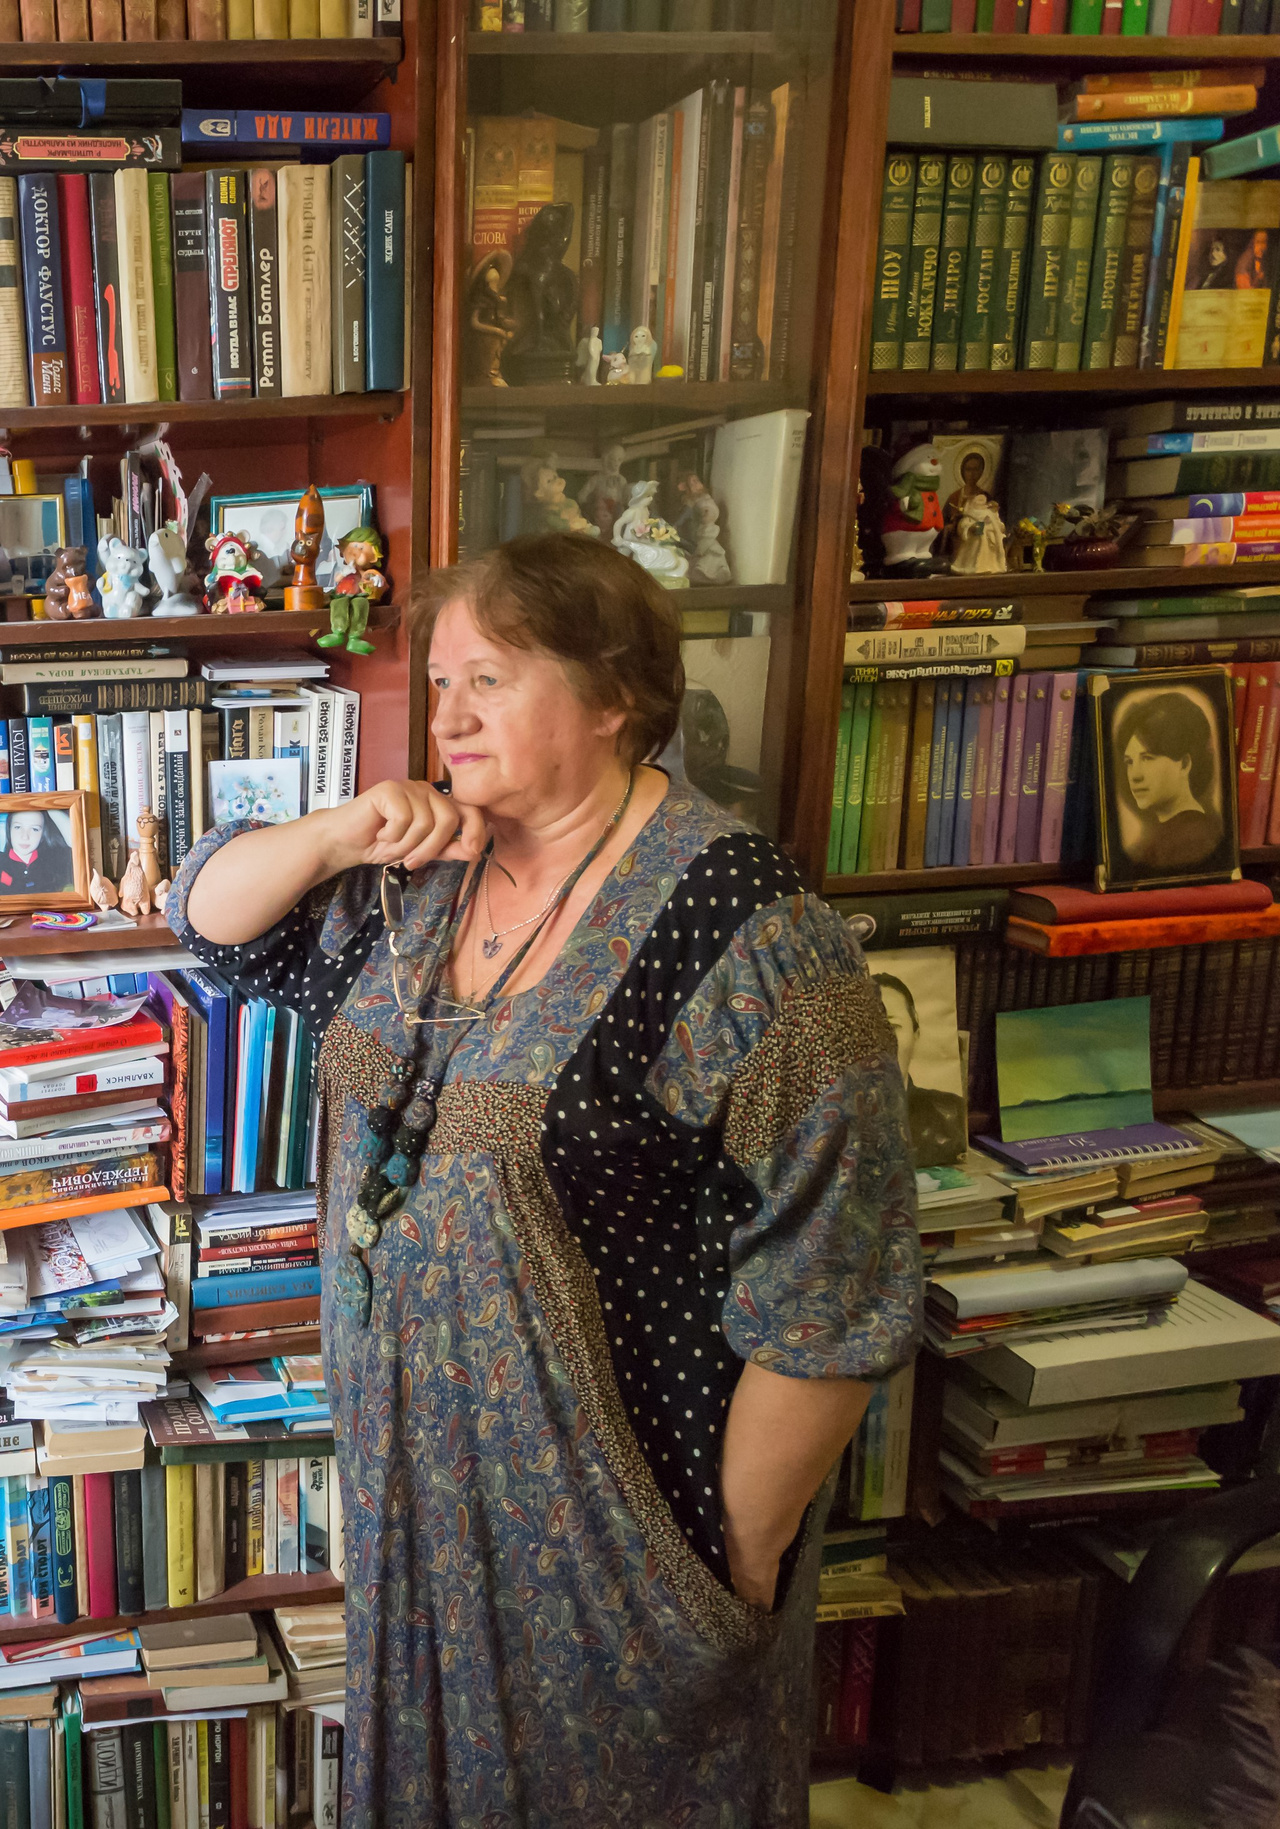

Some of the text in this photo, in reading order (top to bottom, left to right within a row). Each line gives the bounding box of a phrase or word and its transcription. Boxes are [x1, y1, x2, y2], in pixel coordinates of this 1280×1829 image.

[78, 139, 121, 148] НАСЛЕДНИК
[254, 115, 379, 141] ЖИТЕЛИ АДА
[47, 148, 92, 158] ШТИЛЬМАРК
[220, 176, 229, 204] ЛЕОНИД
[228, 176, 236, 204] СЛОВИН
[153, 183, 166, 242] МАКСИМОВ
[301, 176, 314, 240] ПЕРВЫЙ
[384, 210, 393, 234] САНД
[472, 232, 508, 244] СЛОВА
[31, 186, 56, 345] ДОКТОР ФАУСТУС
[880, 248, 901, 300] ШОУ
[943, 250, 962, 313] ДИДРО
[976, 248, 994, 314] РОСТАН
[1043, 250, 1061, 297] ПРУС
[1100, 248, 1119, 310] БРОНТЕ
[219, 218, 240, 368] КОГДА НАС СТРЕЛЯЮТ
[917, 247, 938, 338] БОККАЧЧО
[258, 248, 274, 388] Ретт Батлер
[41, 360, 53, 394] Манн
[52, 359, 64, 393] Томас
[44, 652, 56, 660] ДО
[81, 651, 92, 659] ОТ
[97, 650, 129, 658] ГУМИЛЕВ
[49, 670, 74, 678] ПОРА
[13, 729, 25, 766] ИУДЫ
[315, 745, 326, 794] ИМЕНЕМ
[340, 748, 352, 797] ИМЕНЕМ
[174, 754, 187, 864] Встречи зале ожидания
[106, 1072, 154, 1084] ХВАЛЫНСК
[17, 1145, 45, 1157] ЯЩИК
[22, 1151, 74, 1167] ПОЛЯКОВ
[51, 1165, 149, 1188] ГЕРЖЕДОВИЧ
[219, 1224, 307, 1240] ЕВАНГЕЛИЕ ОТ ИИСУСА
[251, 1260, 312, 1271] ПОДНЯВШИЙСЯ
[226, 1284, 285, 1299] КАПИТАНА
[164, 1401, 192, 1435] ПРАВО
[250, 1491, 261, 1530] ЛЮБОВЬ
[37, 1538, 50, 1608] МЕРИ СТЮАРТ
[96, 1742, 119, 1789] ИДИОТ
[214, 1734, 222, 1763] НОРТОН
